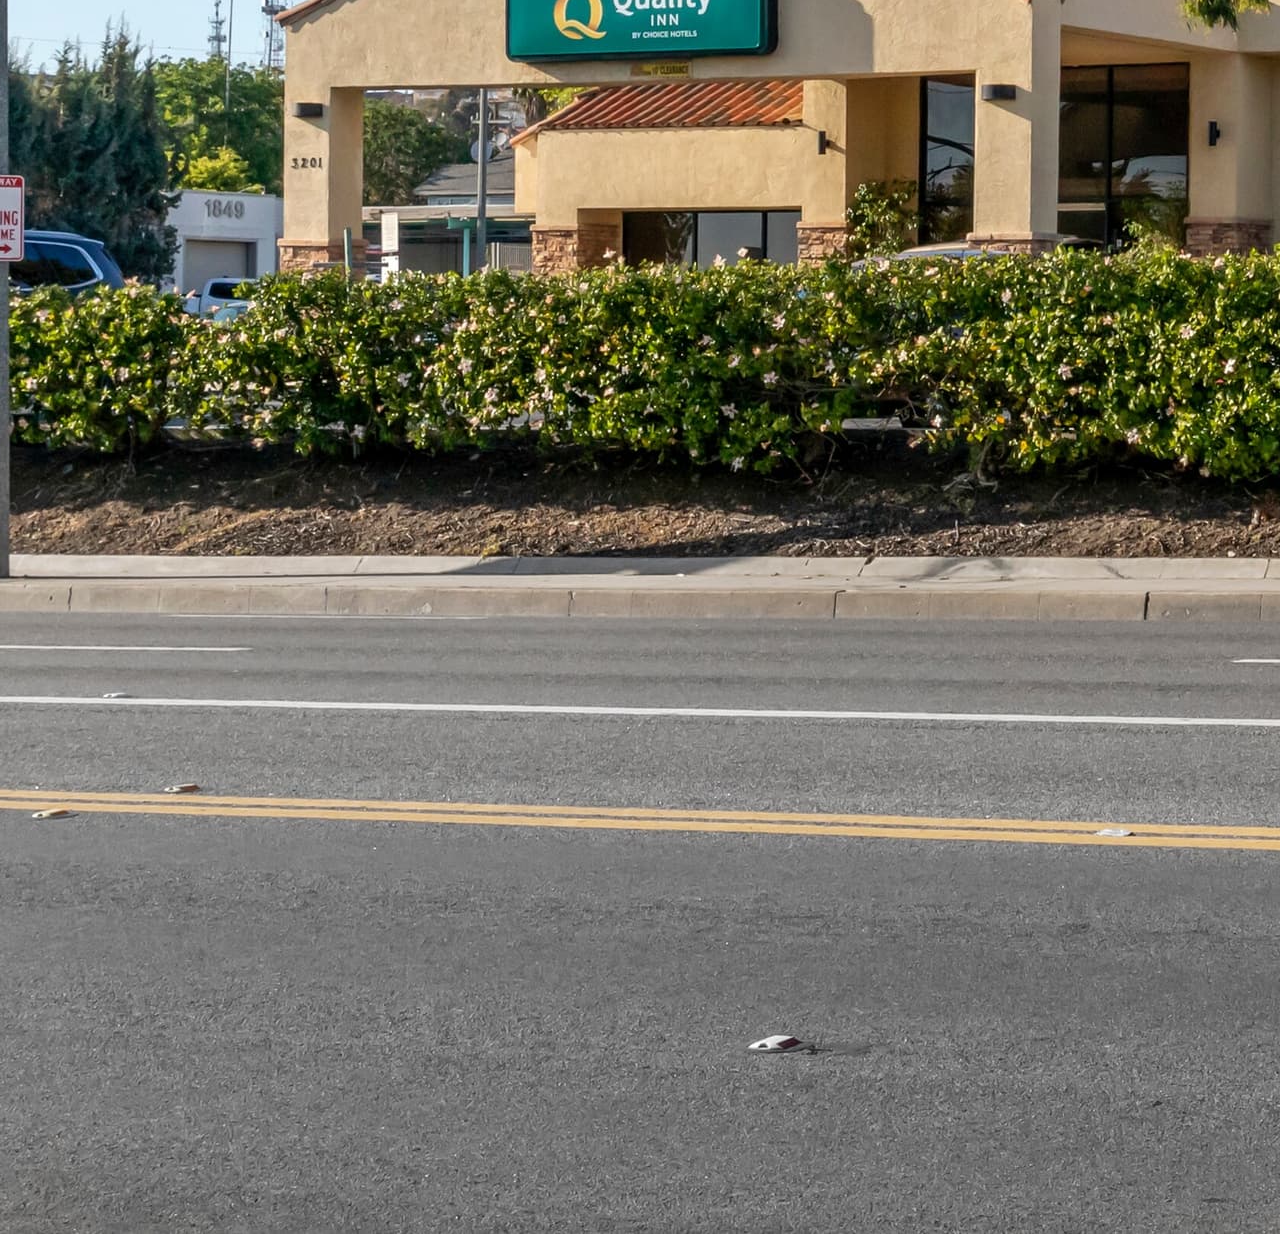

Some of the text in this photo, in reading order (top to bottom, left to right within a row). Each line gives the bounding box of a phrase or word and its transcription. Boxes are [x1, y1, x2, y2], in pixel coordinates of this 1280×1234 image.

[650, 14, 680, 27] INN
[631, 29, 697, 39] BY CHOICE HOTELS
[290, 157, 324, 170] 3201
[204, 199, 245, 219] 1849
